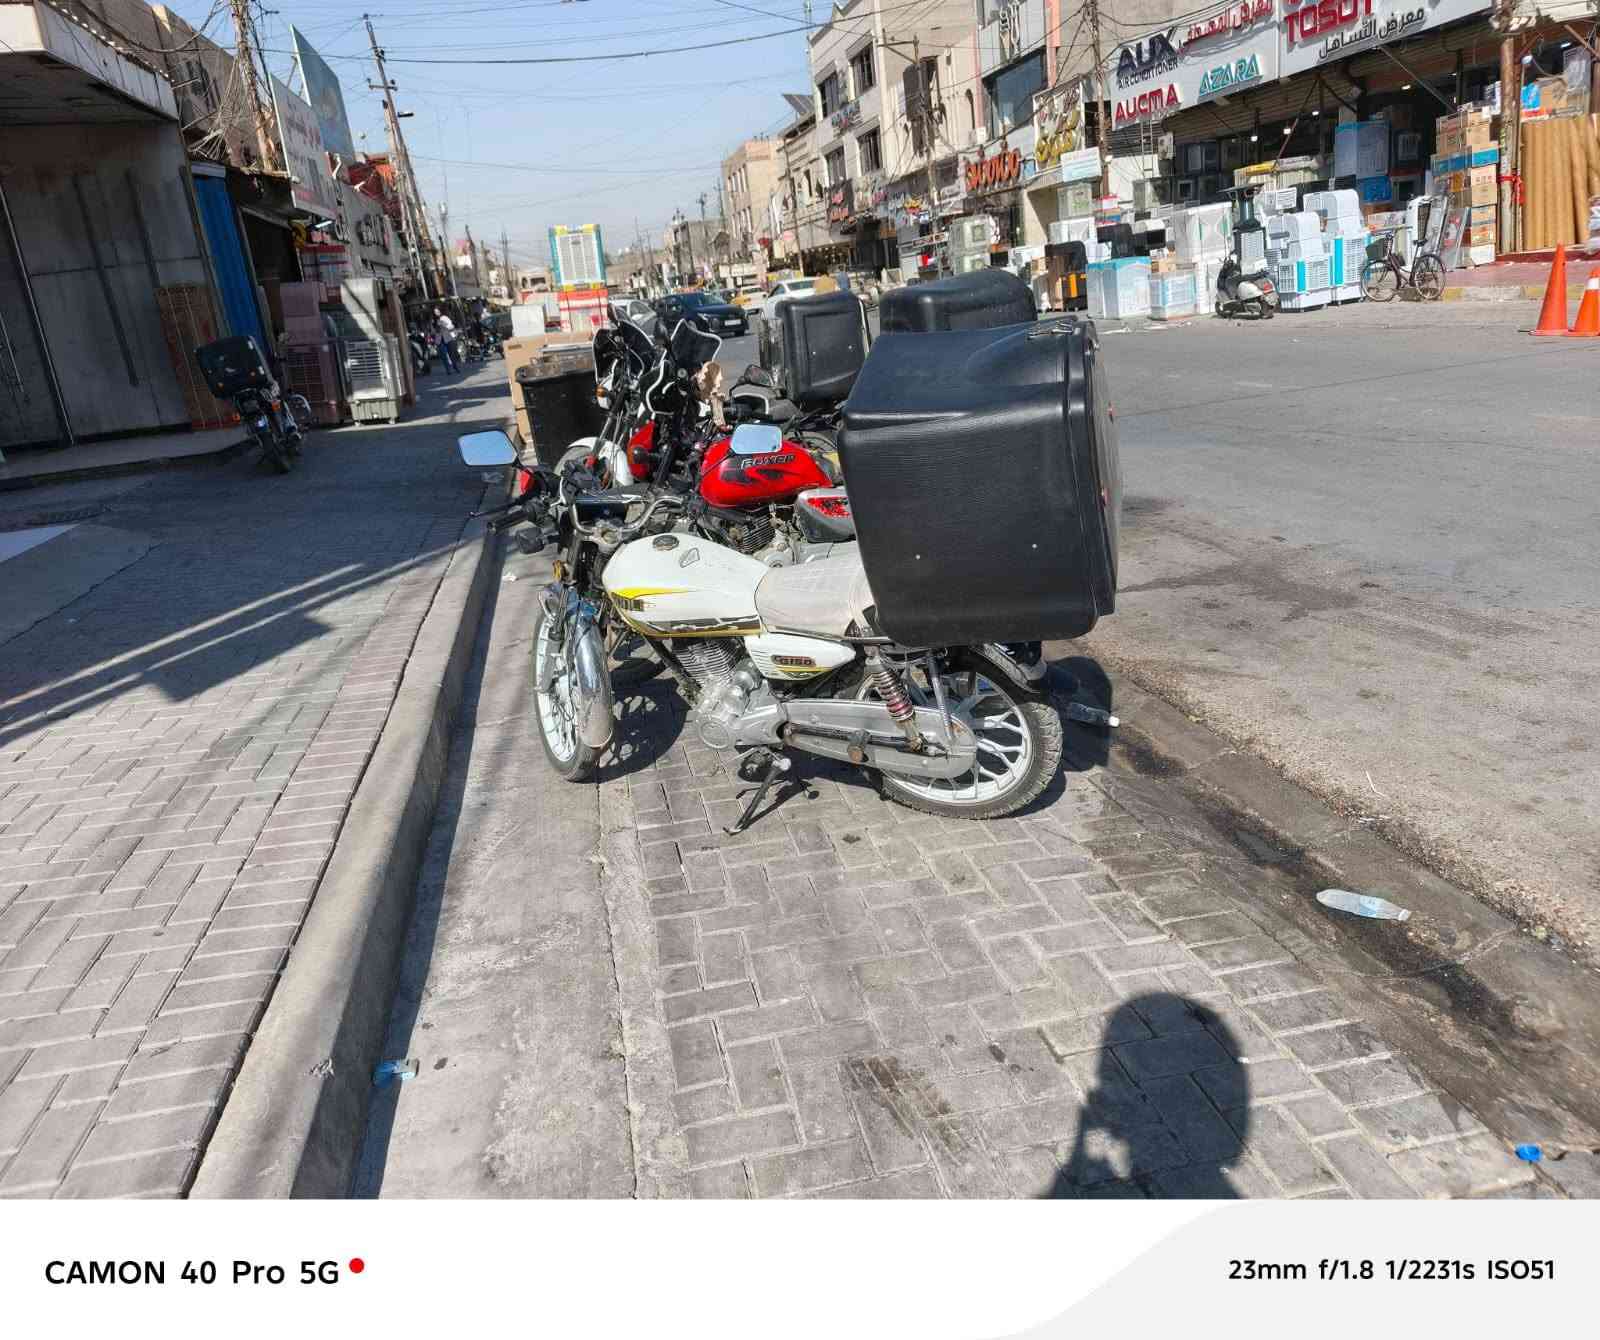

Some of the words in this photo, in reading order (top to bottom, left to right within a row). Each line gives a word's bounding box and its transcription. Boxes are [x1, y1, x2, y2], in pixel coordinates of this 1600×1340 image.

[1378, 7, 1425, 39] معرض
[1117, 27, 1177, 76] AUX
[1118, 77, 1129, 91] AIR
[1128, 56, 1179, 87] CONDITIONER
[1199, 53, 1261, 96] AZARA
[1115, 83, 1179, 122] AUCMA
